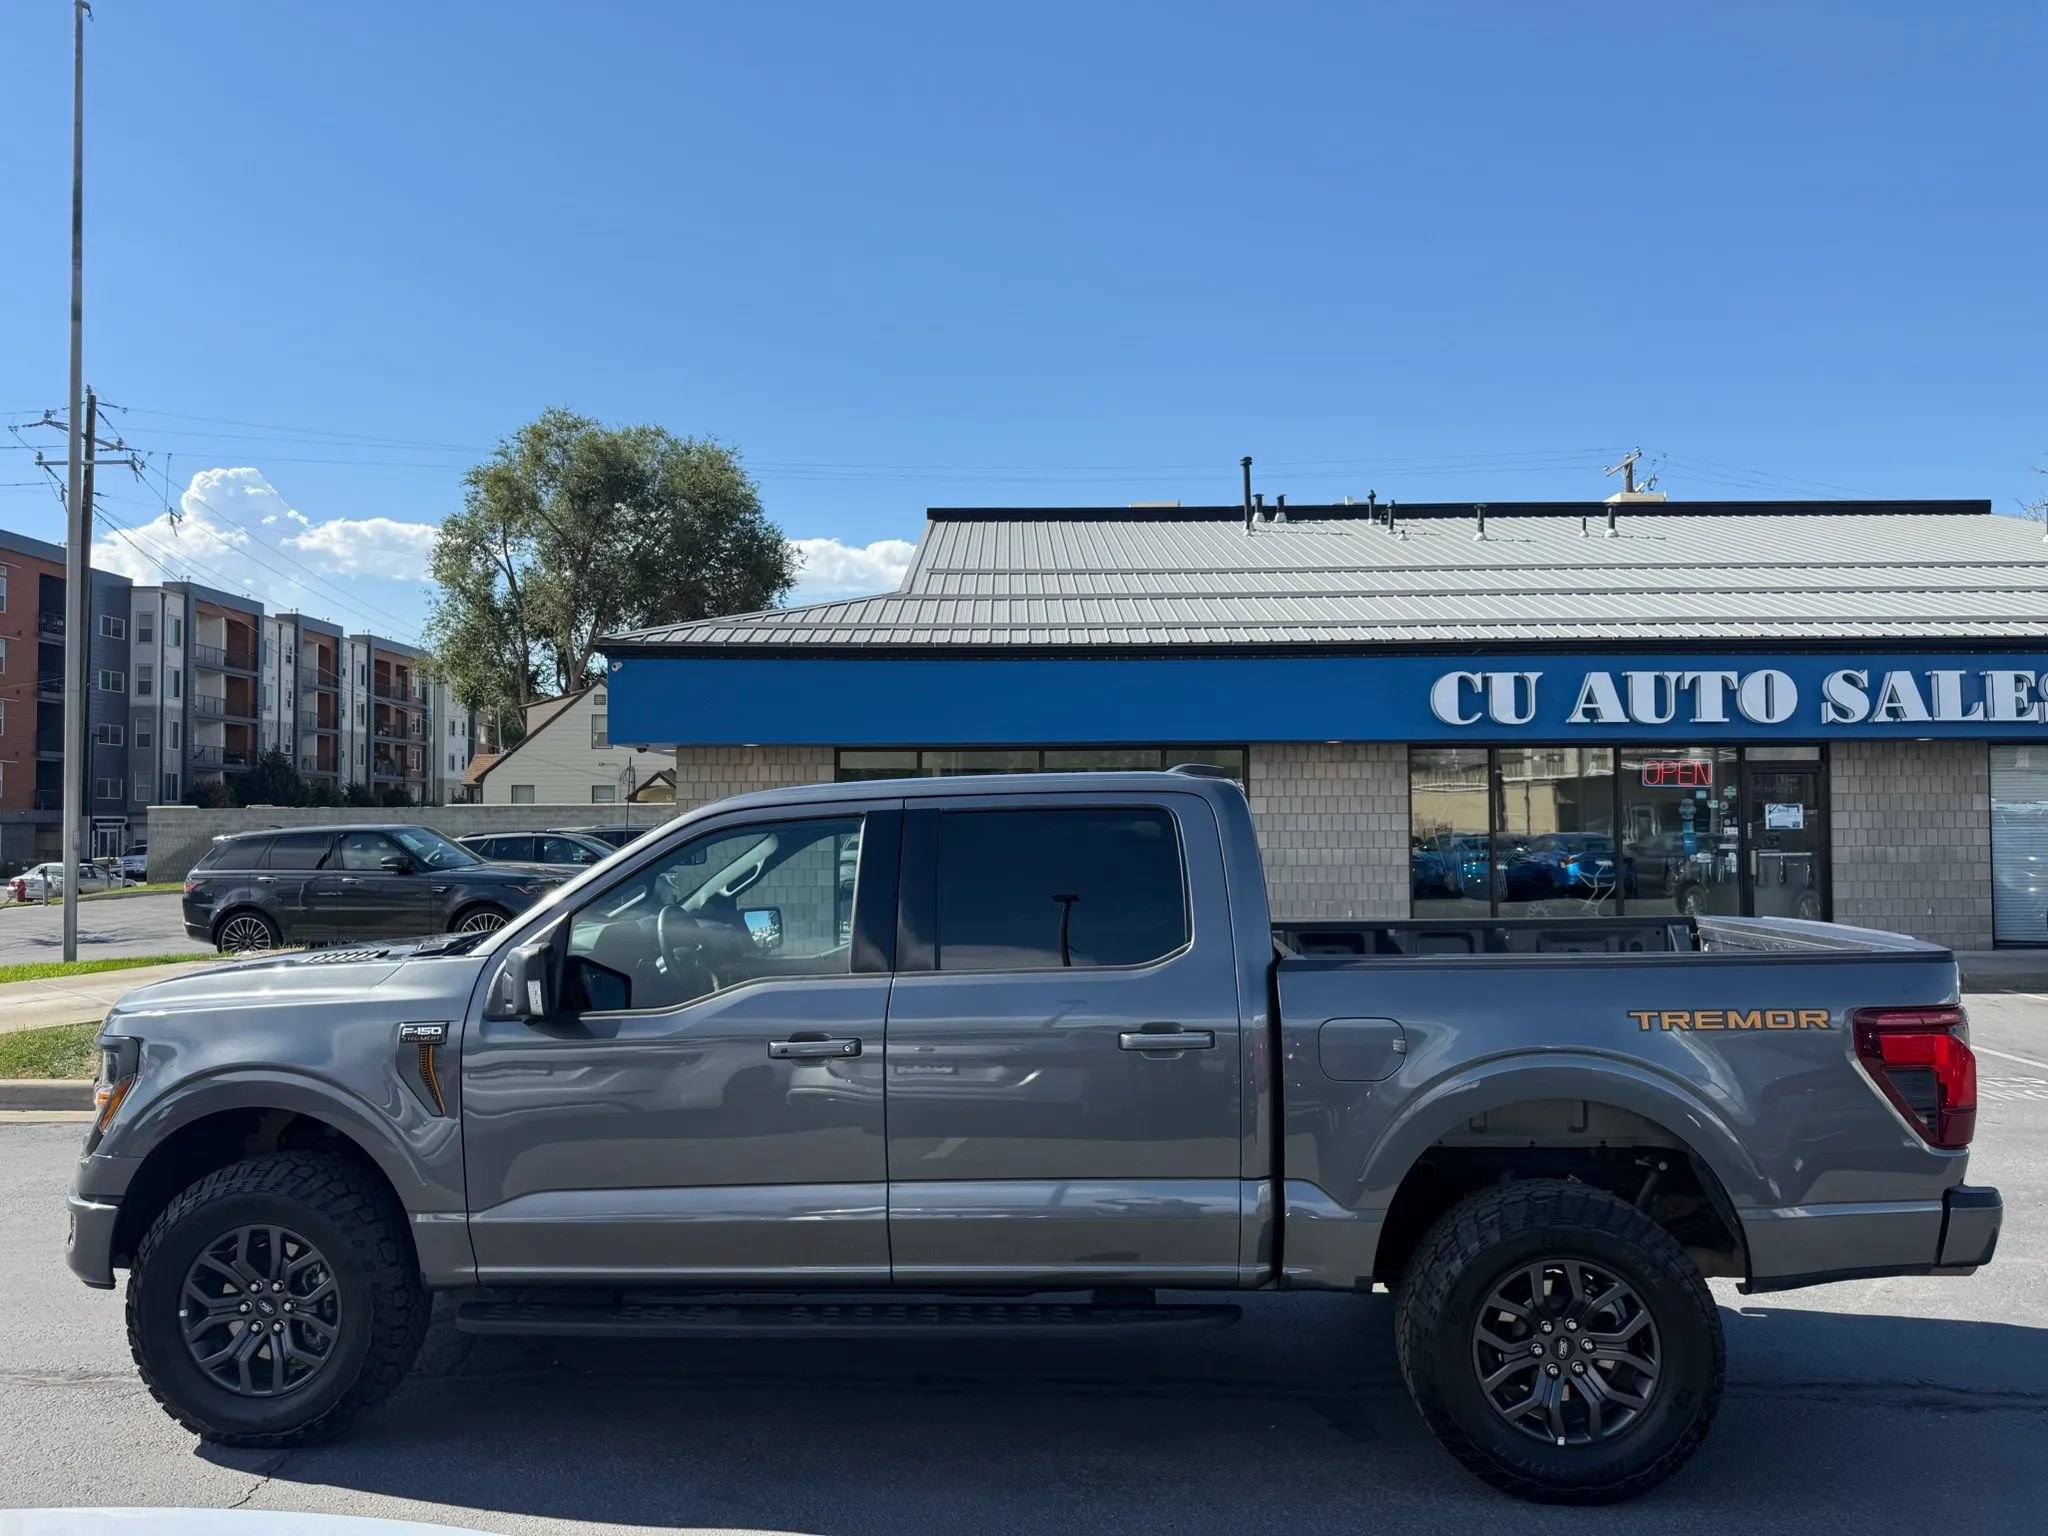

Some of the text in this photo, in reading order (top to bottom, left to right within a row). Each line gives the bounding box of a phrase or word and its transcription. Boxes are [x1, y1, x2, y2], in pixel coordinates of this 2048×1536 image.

[1430, 669, 2048, 726] CU AUTO SALE
[1645, 760, 1711, 785] OPEN
[402, 1026, 442, 1035] F-150
[1628, 1009, 1831, 1031] TREMOR
